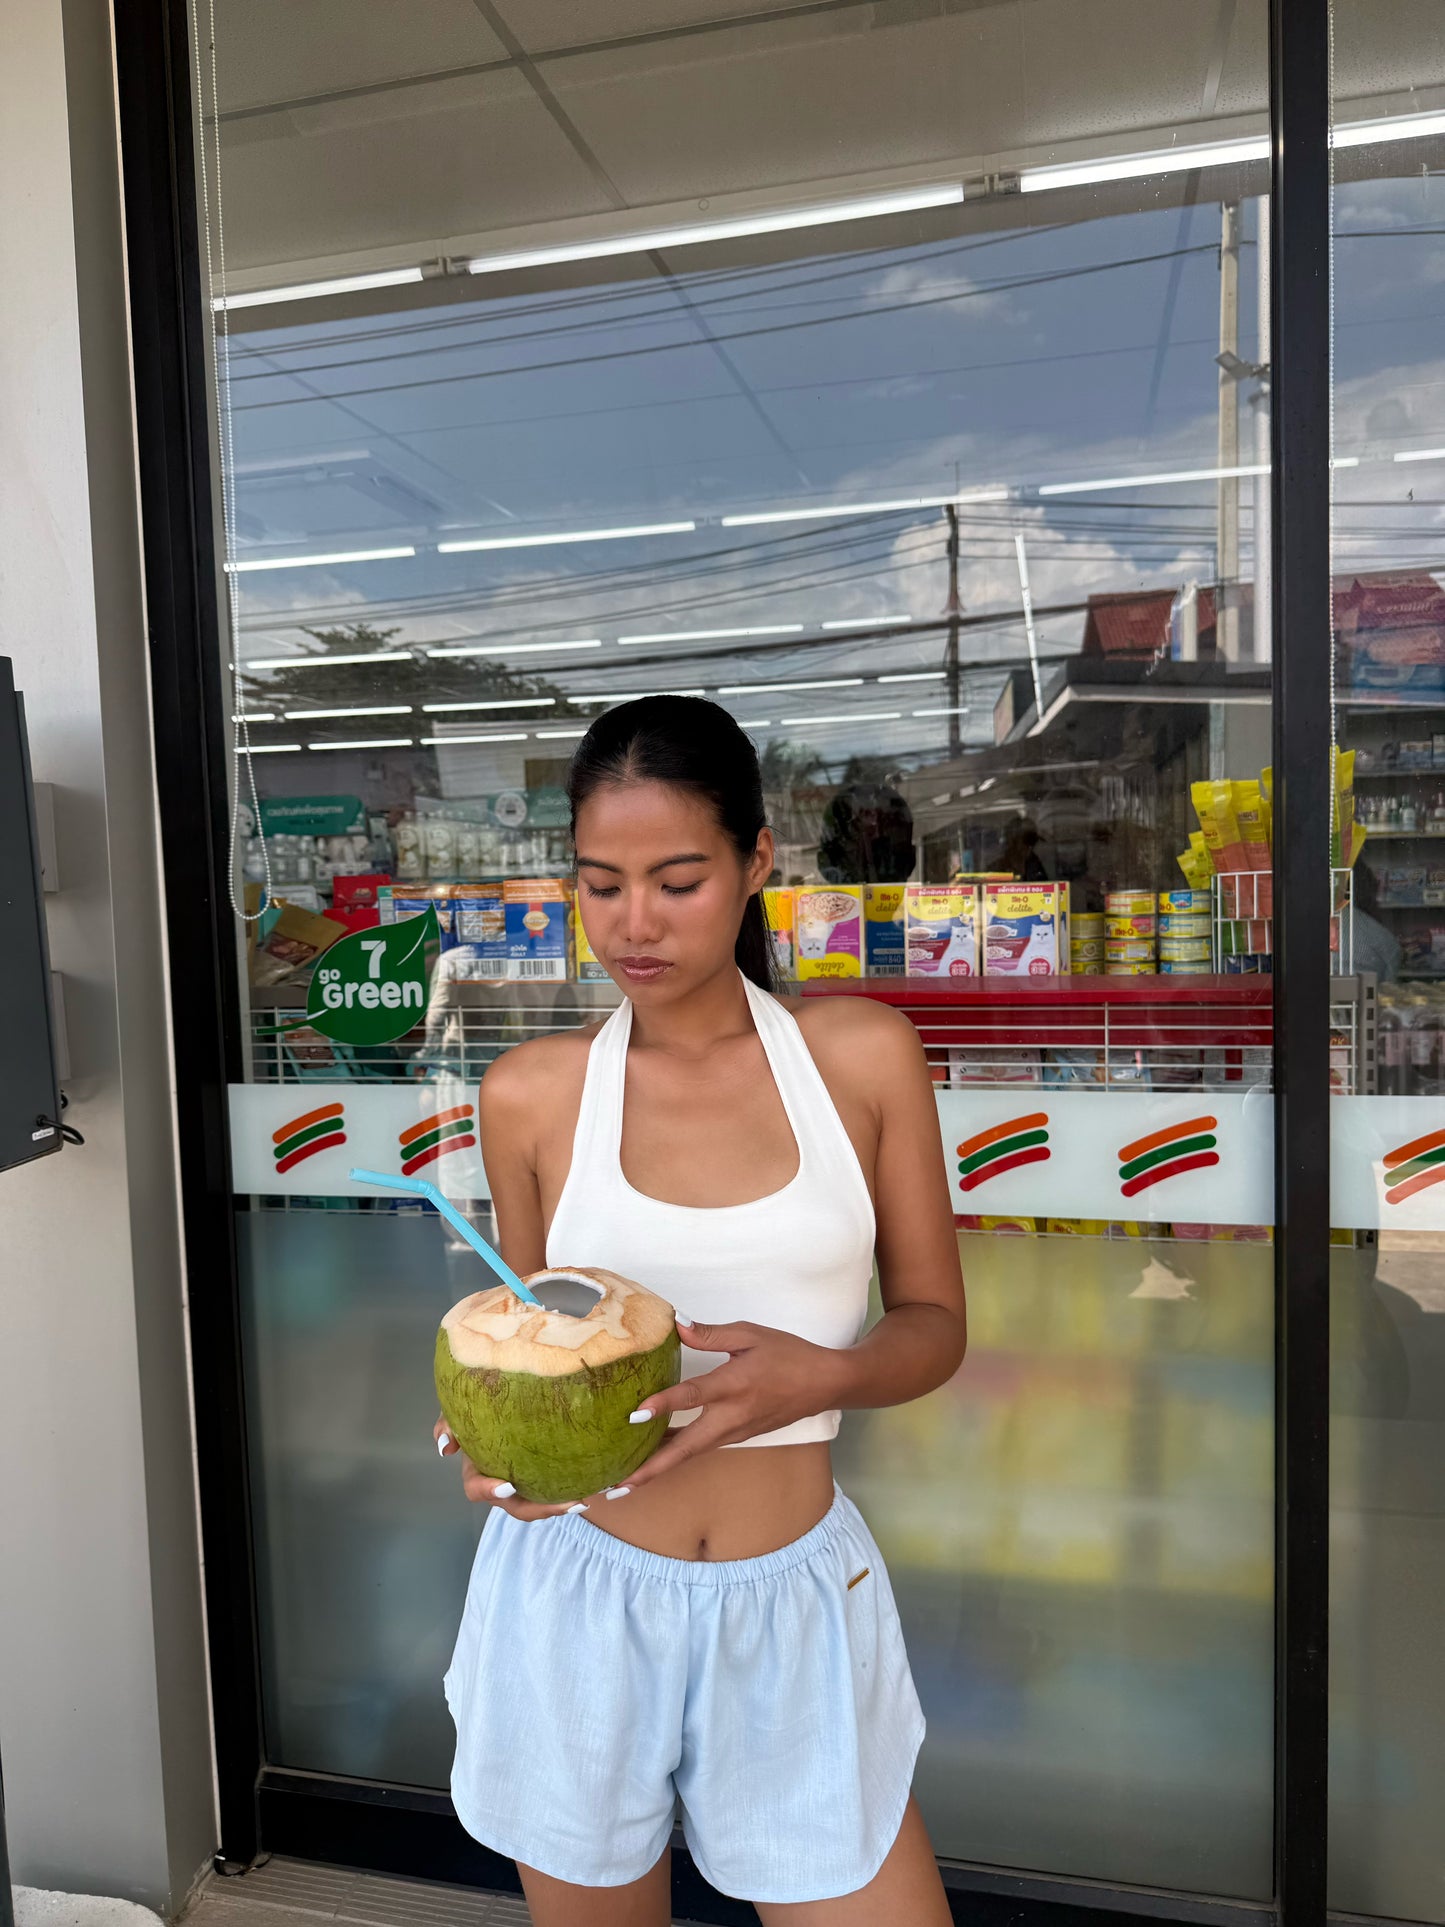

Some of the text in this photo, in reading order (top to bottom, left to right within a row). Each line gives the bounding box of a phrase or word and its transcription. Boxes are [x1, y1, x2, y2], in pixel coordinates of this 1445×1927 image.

[1115, 928, 1134, 936] Me-O
[361, 940, 387, 979] 7
[322, 980, 424, 1010] Green
